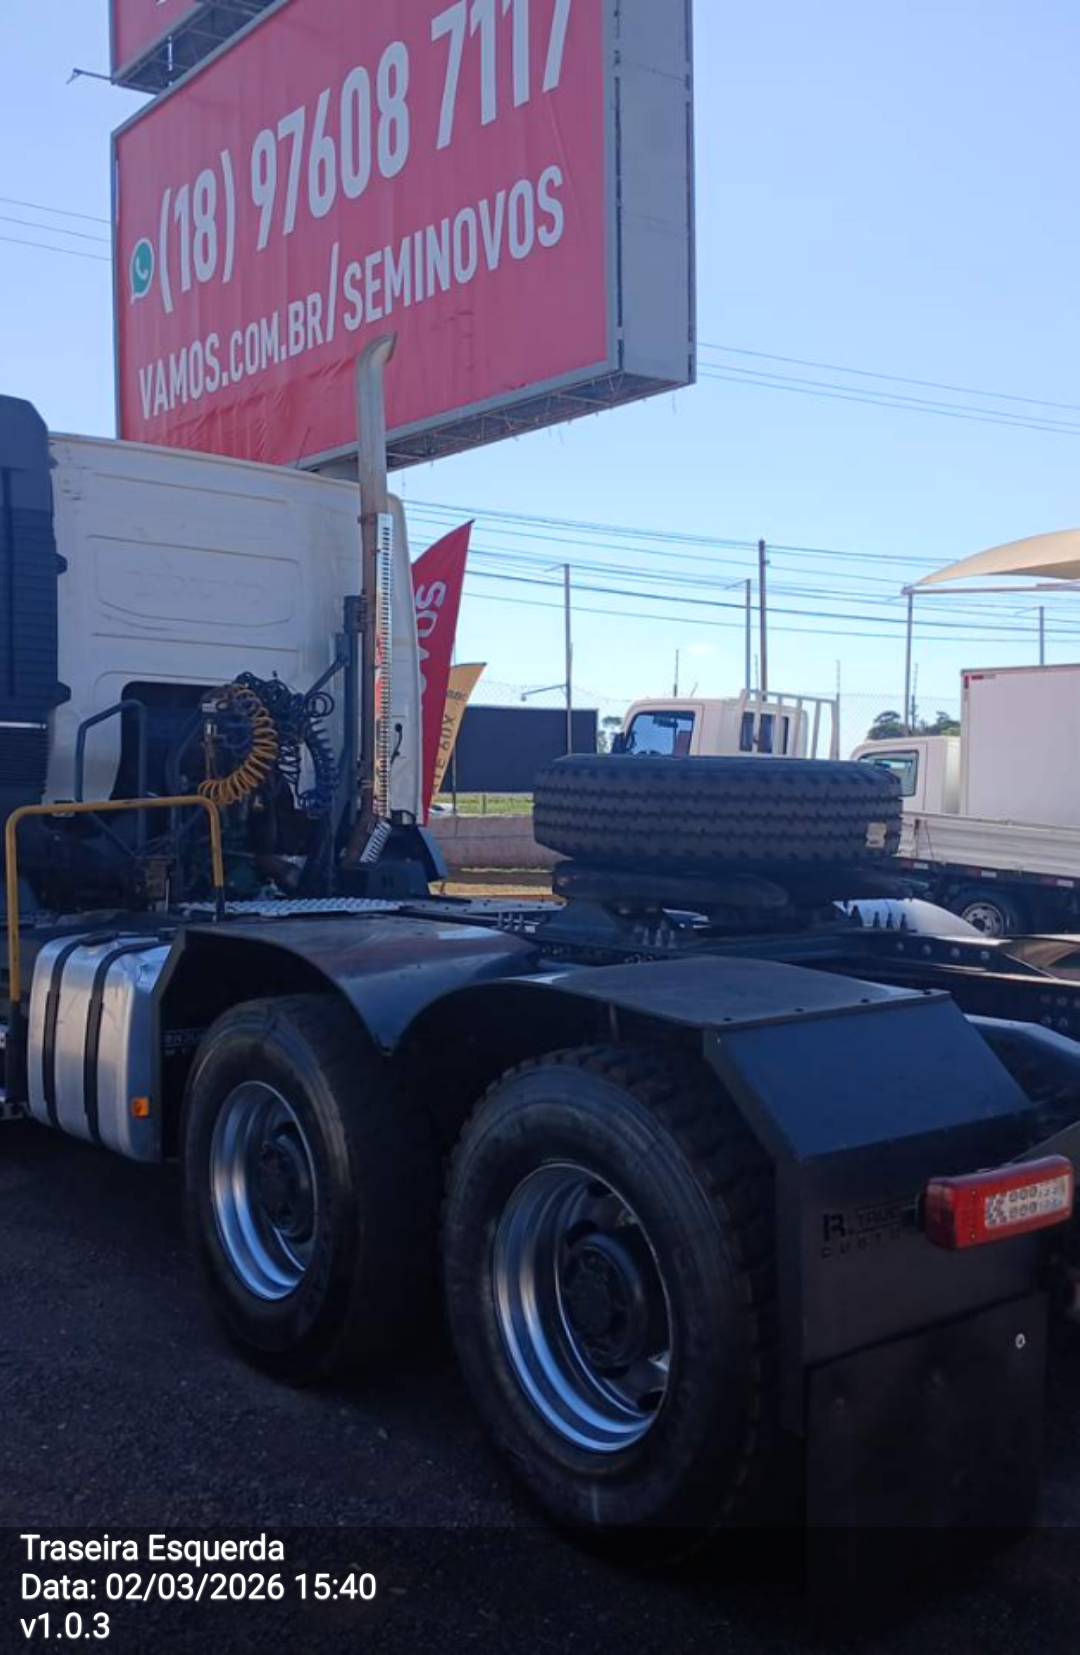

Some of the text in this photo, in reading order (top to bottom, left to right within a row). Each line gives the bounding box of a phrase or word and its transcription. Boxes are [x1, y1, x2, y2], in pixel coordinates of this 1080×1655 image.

[138, 165, 566, 420] VAMOS.COM.BR/SEMINOVOS
[159, 149, 236, 315] (18)
[251, 40, 410, 252] 97608
